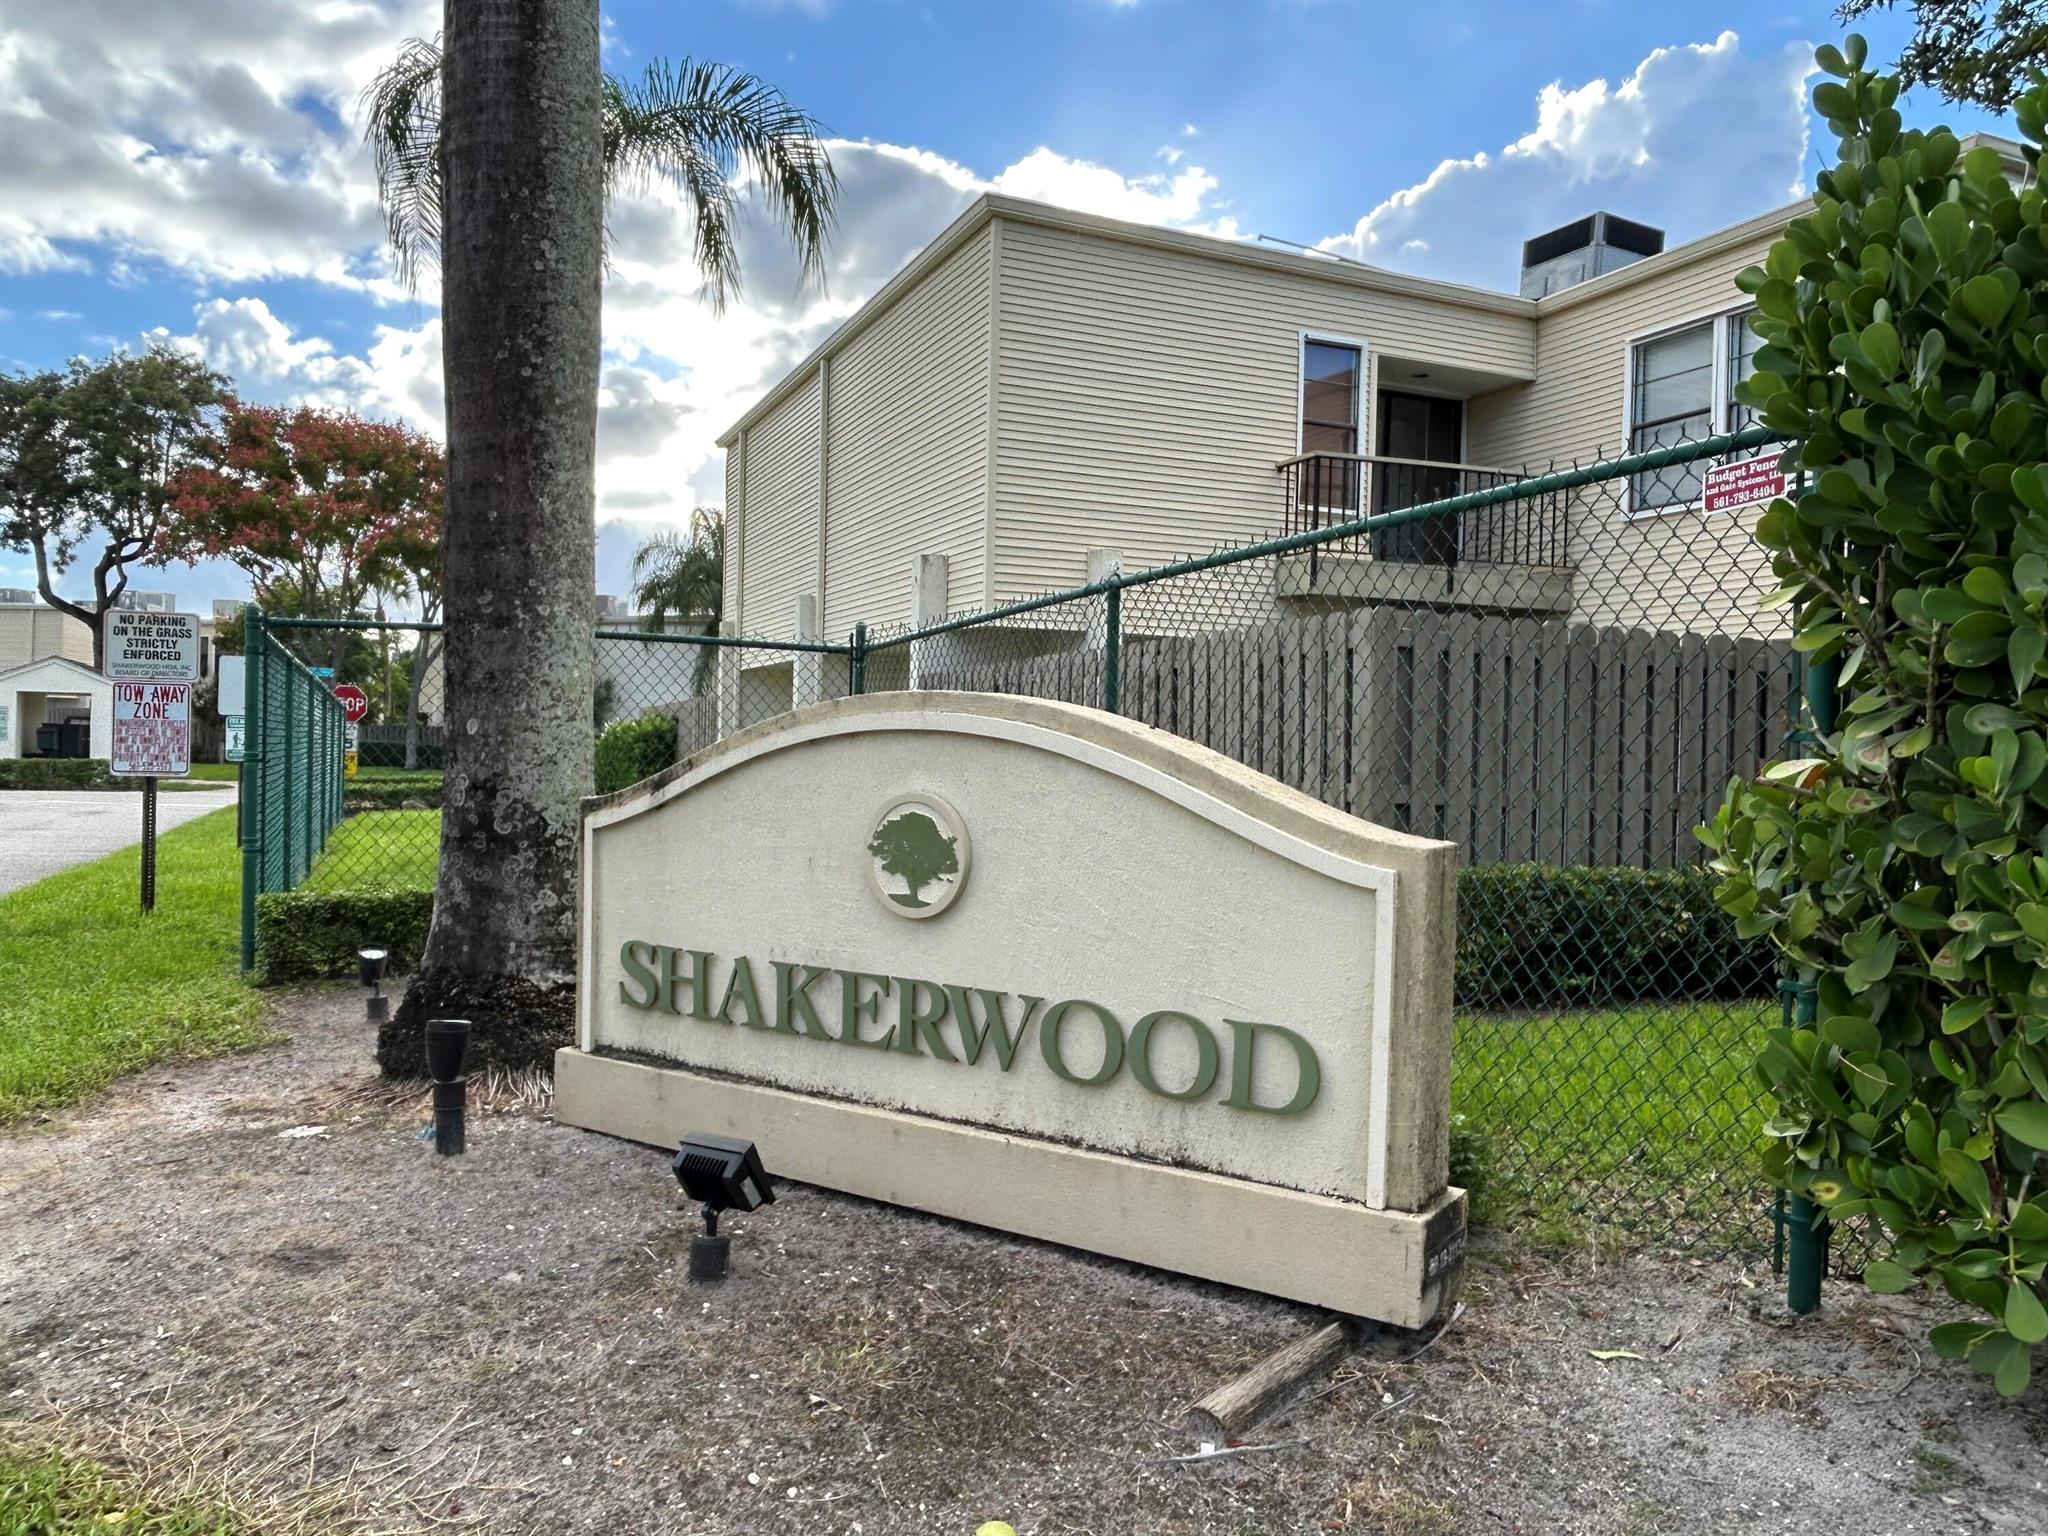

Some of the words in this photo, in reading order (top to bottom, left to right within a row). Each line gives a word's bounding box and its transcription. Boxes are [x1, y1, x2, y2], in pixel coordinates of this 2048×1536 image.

[1707, 466, 1747, 485] Budget
[1720, 481, 1737, 492] Gate
[119, 614, 134, 625] NO
[138, 616, 186, 627] PARKING
[113, 626, 128, 636] ON
[132, 627, 153, 637] THE
[156, 628, 192, 639] GRASS
[126, 638, 178, 649] STRICTLY
[123, 650, 181, 661] ENFORCED
[116, 685, 145, 702] TOW
[151, 686, 187, 703] AWAY
[133, 703, 169, 719] ZONE
[619, 939, 1321, 1115] SHAKERWOOD
